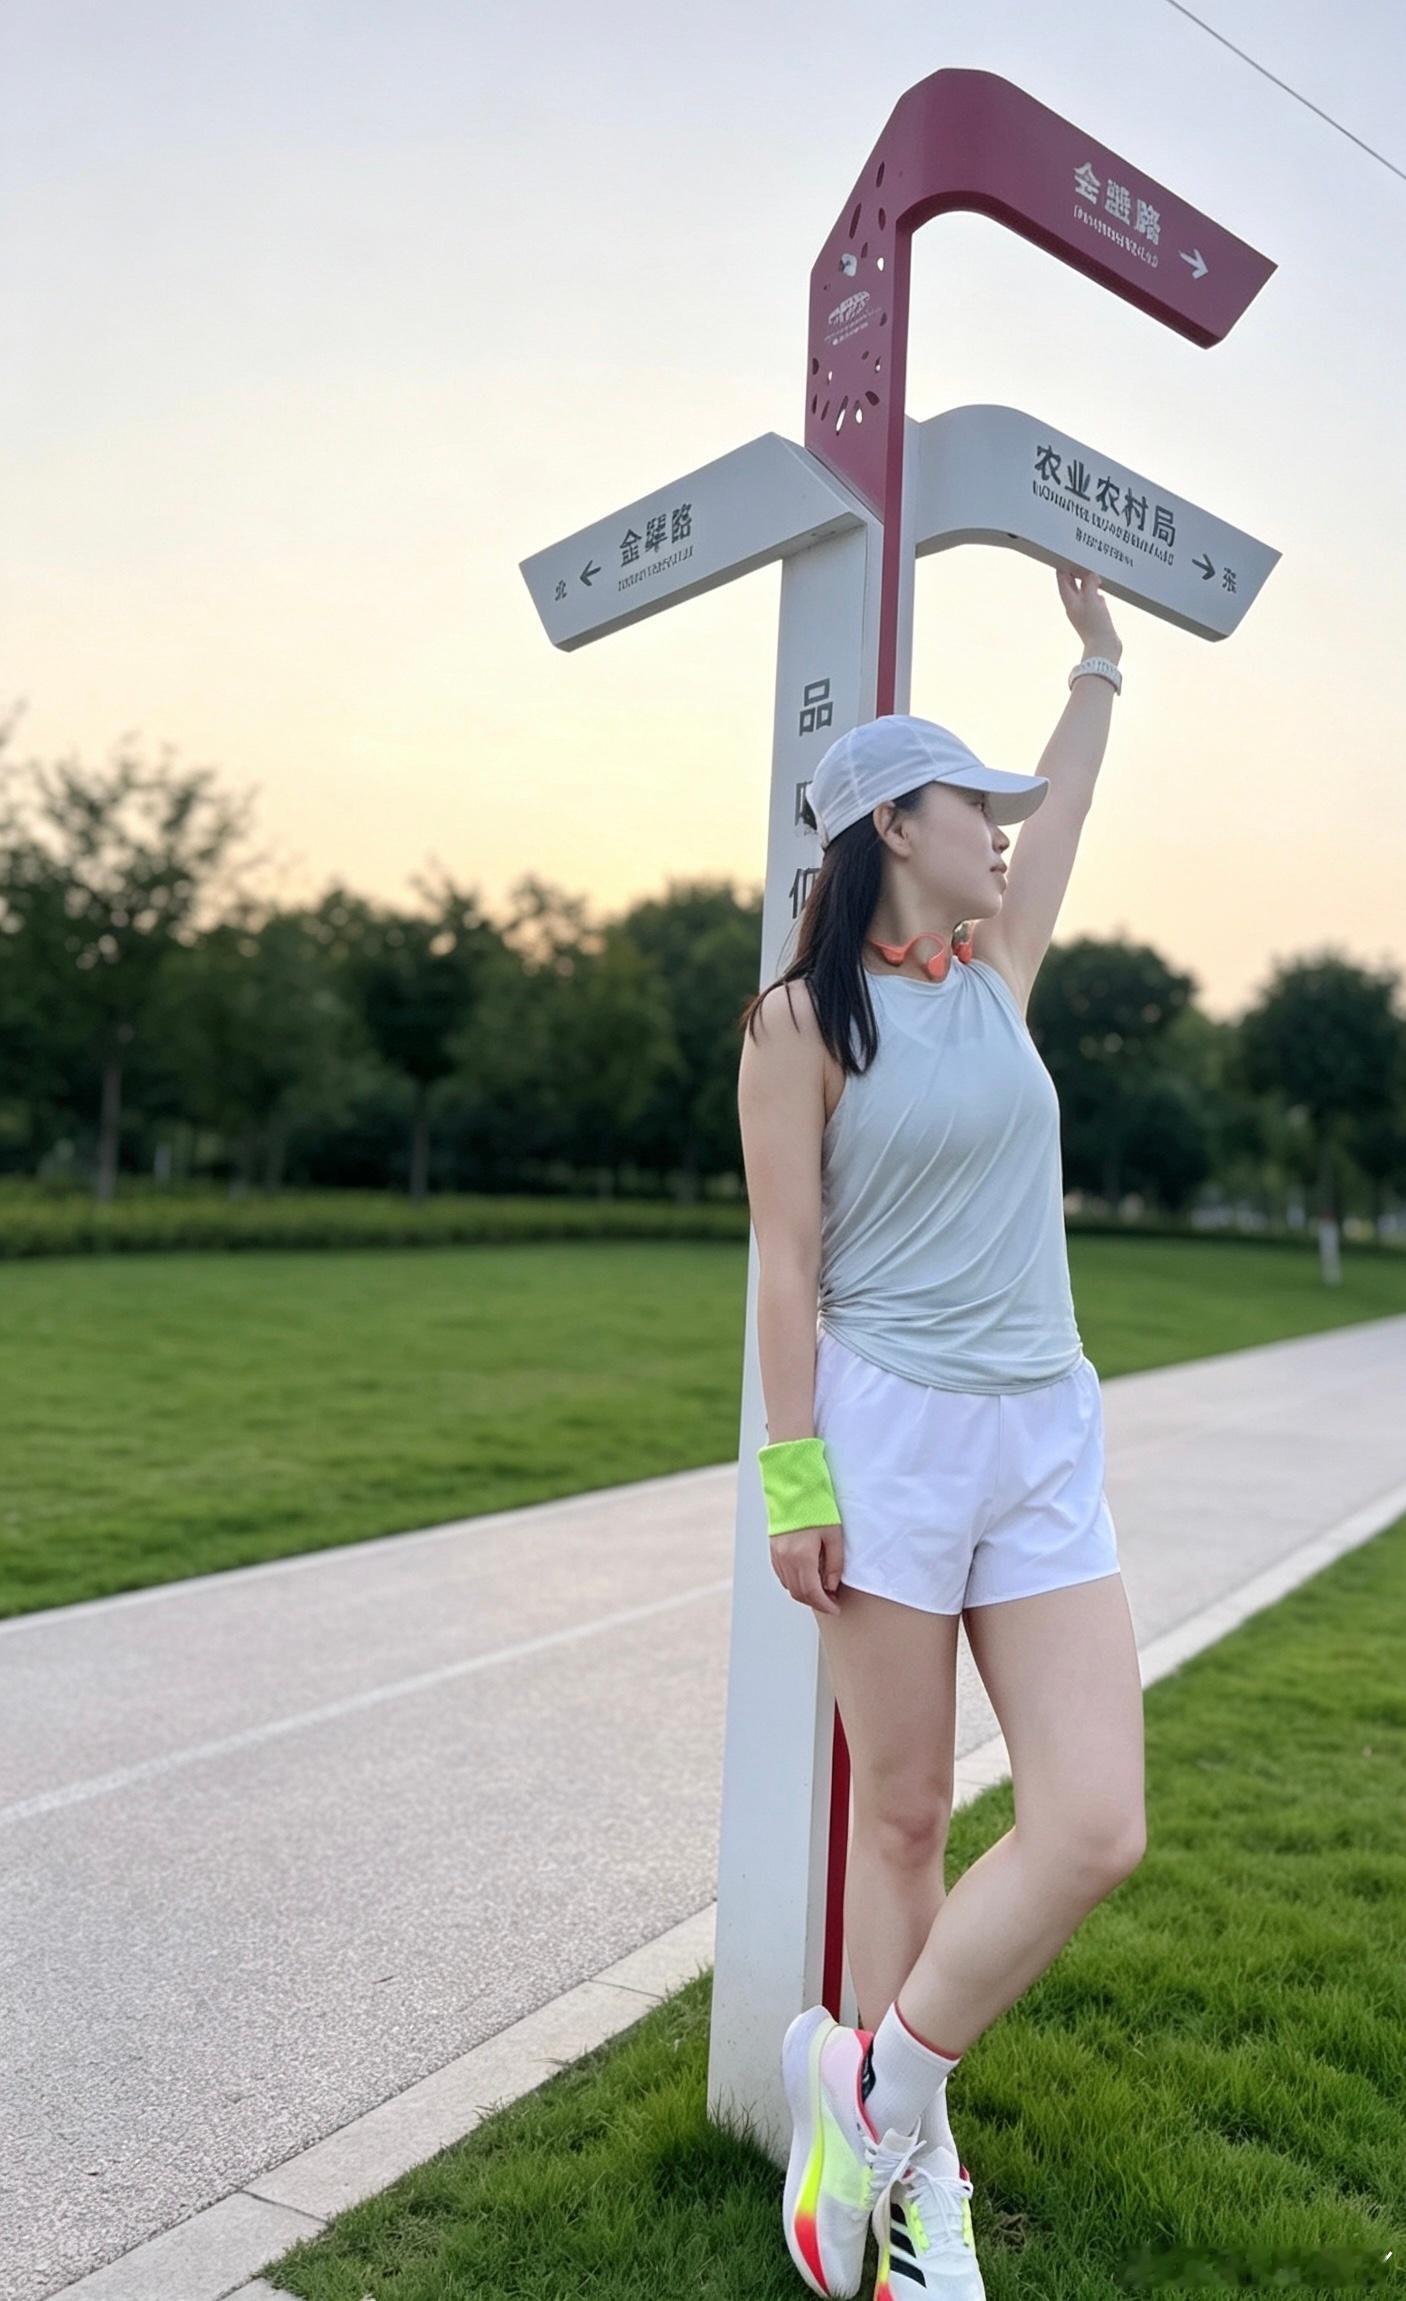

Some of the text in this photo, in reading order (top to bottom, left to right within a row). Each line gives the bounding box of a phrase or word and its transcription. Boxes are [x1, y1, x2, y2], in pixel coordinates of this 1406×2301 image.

[1034, 444, 1177, 549] 农业农村局
